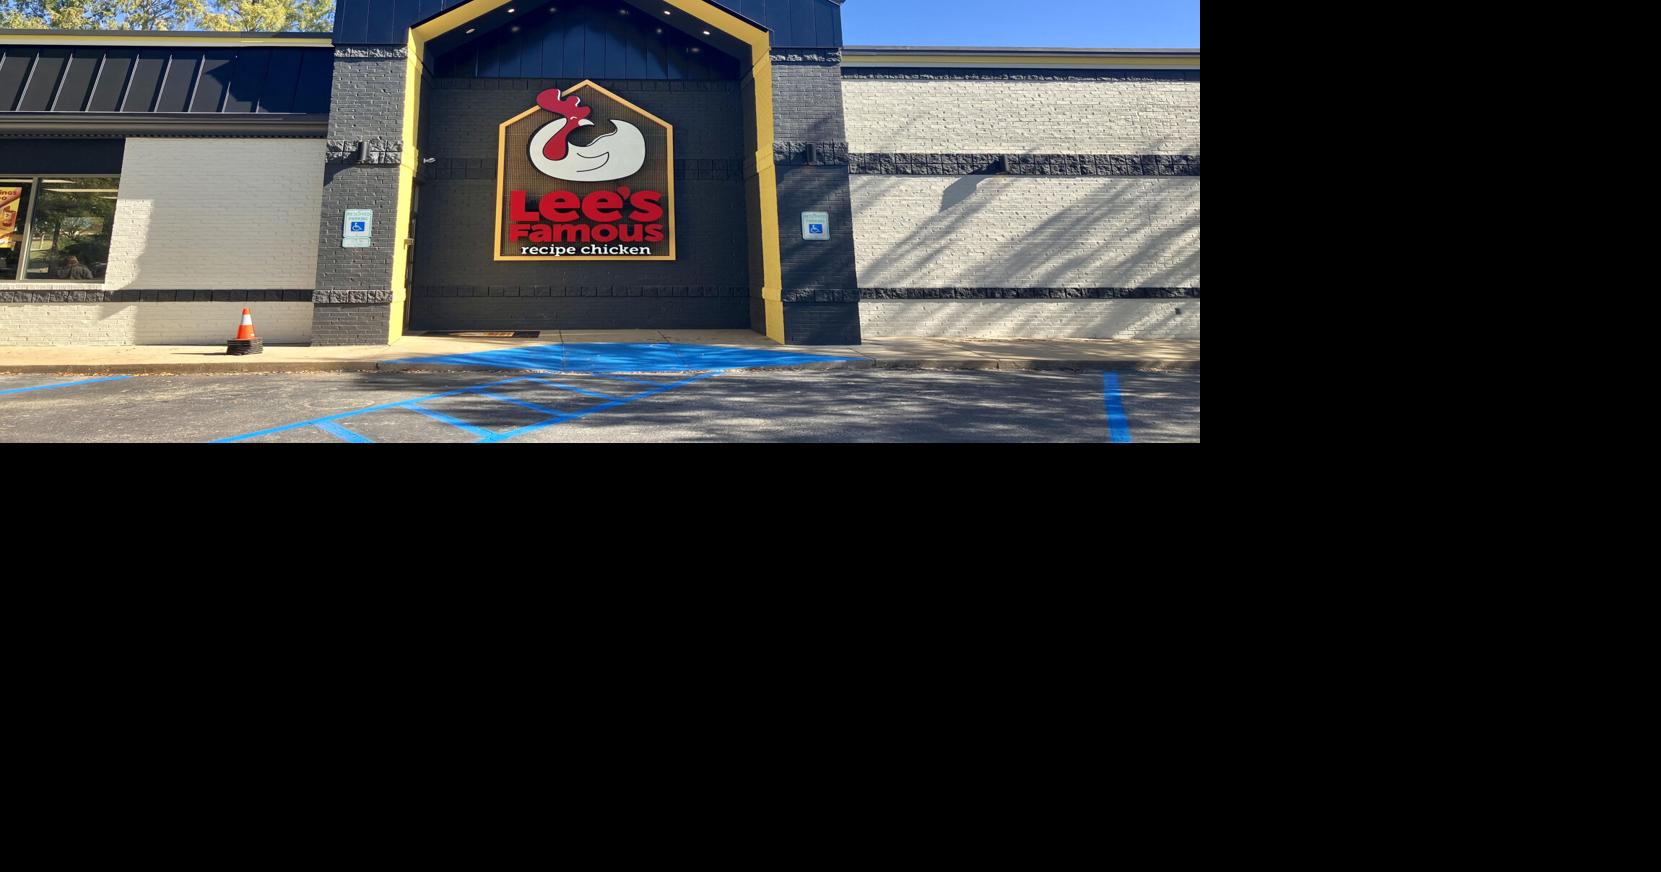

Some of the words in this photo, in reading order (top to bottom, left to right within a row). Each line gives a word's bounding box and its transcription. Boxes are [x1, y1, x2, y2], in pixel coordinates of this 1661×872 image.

[510, 185, 664, 222] Lee's
[509, 223, 664, 243] Famous
[521, 244, 576, 256] recipe
[581, 244, 651, 255] chicken
